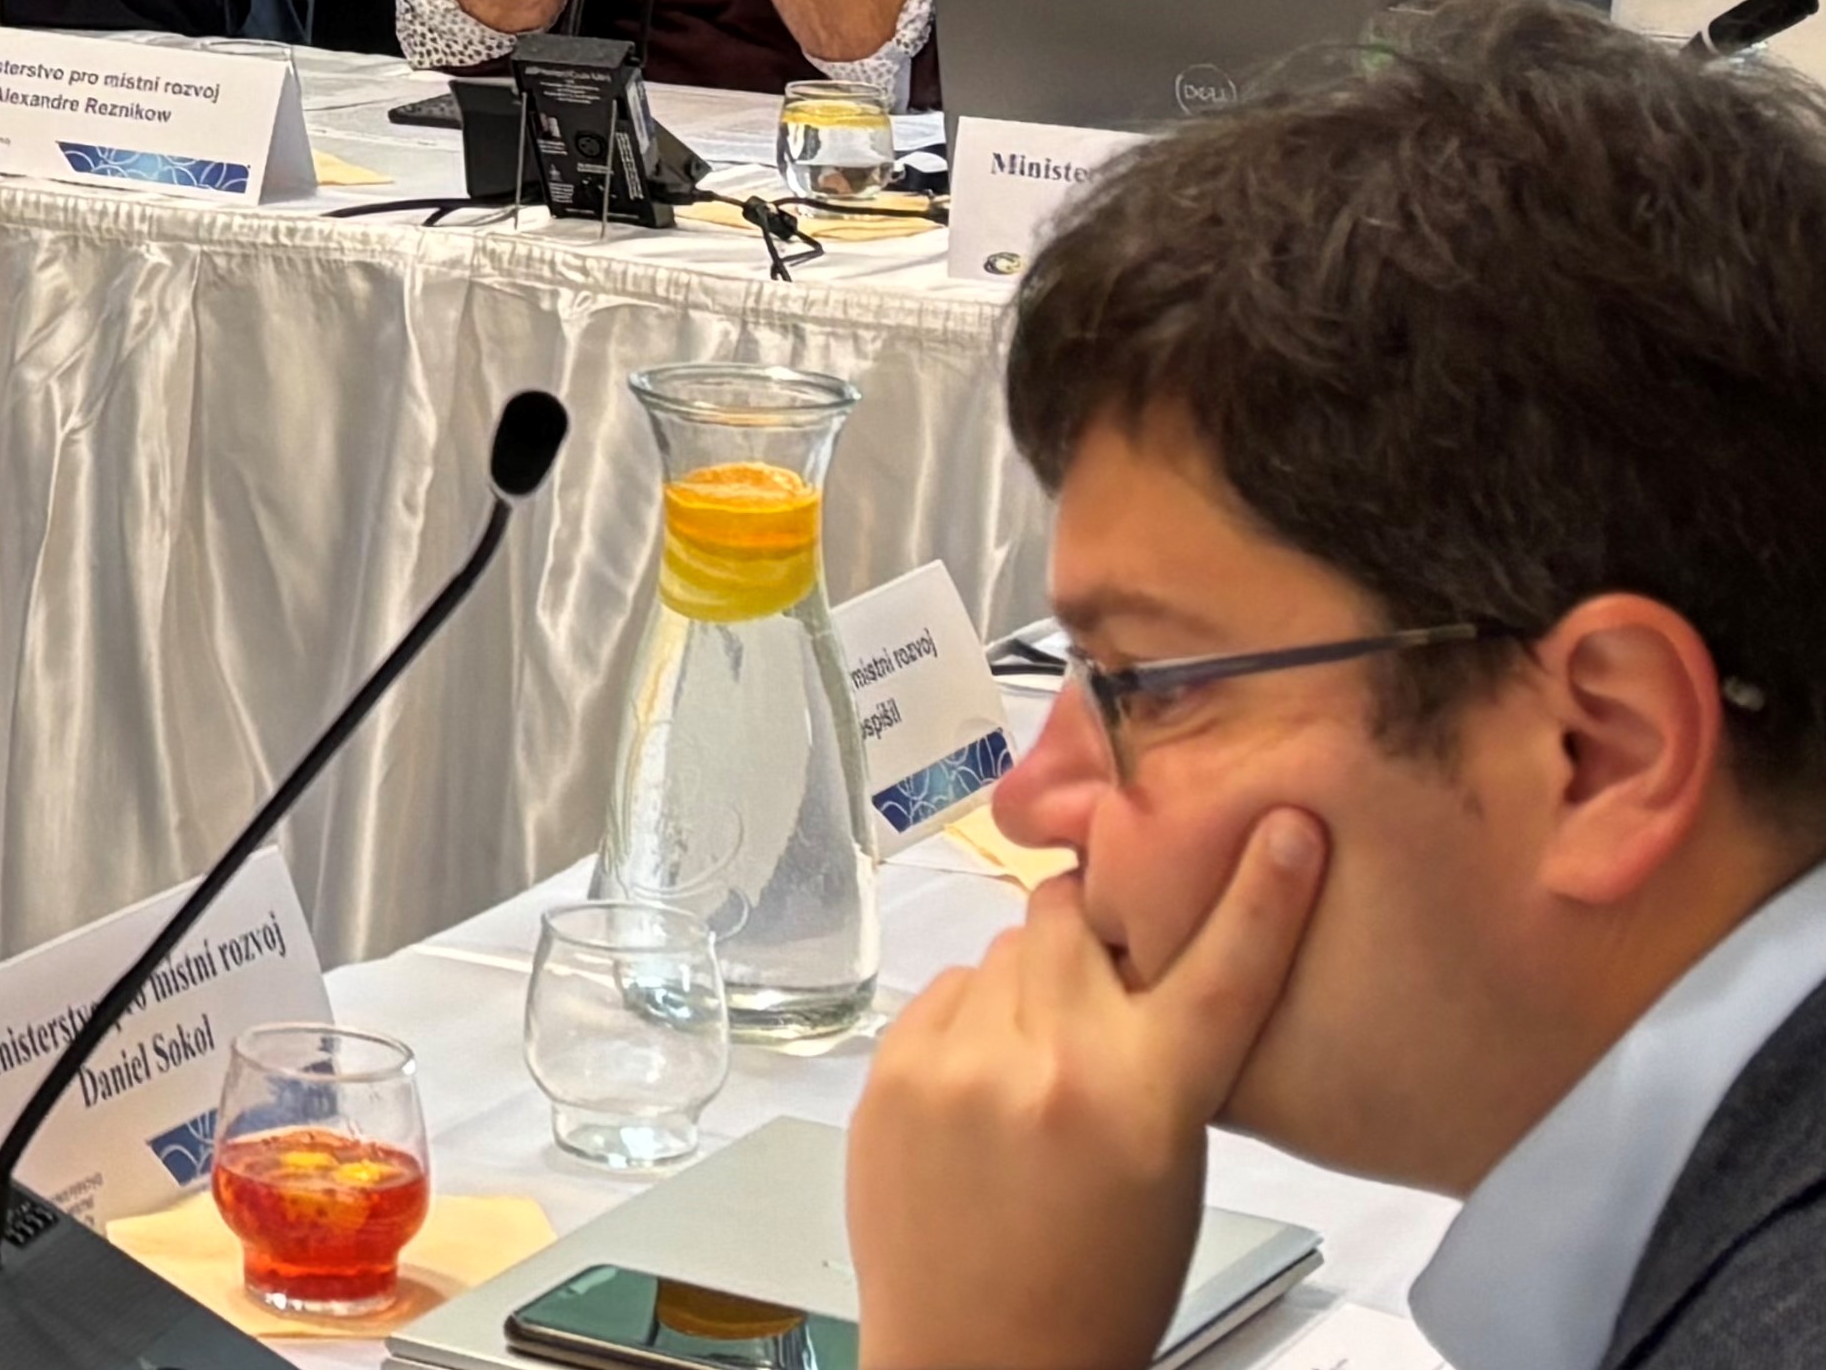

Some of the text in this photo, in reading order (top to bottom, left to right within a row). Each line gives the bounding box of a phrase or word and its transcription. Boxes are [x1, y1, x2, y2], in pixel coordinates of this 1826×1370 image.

[68, 69, 99, 86] pro
[164, 81, 221, 104] rozvoj
[84, 97, 172, 123] Reznikow
[990, 152, 1090, 183] Ministe
[218, 911, 288, 972] rozvoj
[78, 1013, 216, 1108] Daniel Sokol
